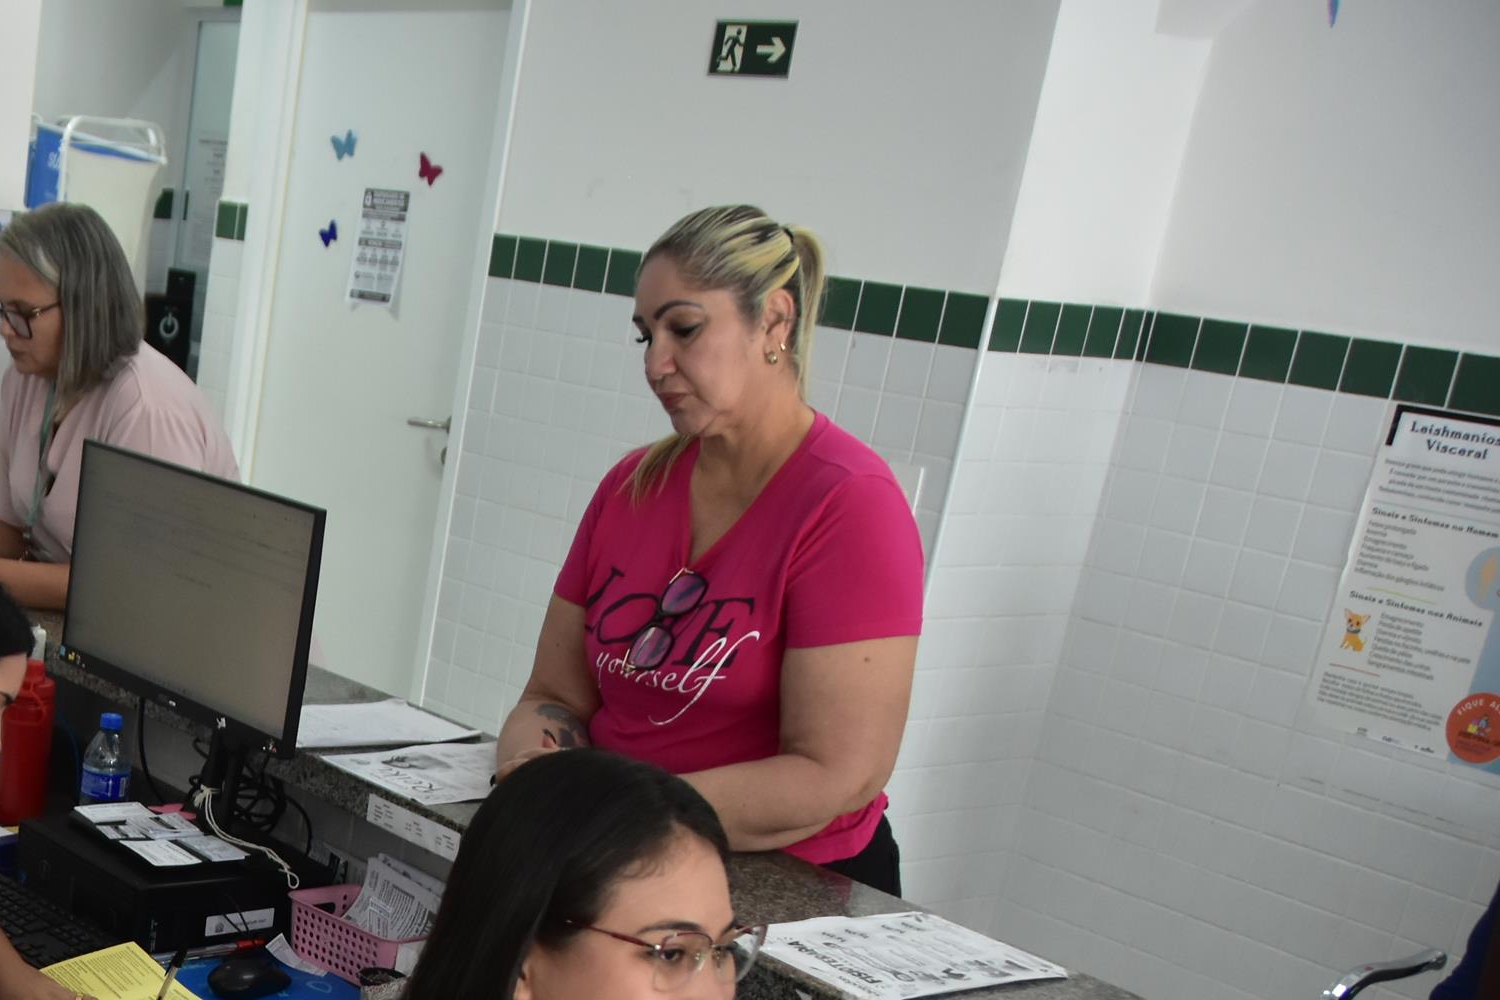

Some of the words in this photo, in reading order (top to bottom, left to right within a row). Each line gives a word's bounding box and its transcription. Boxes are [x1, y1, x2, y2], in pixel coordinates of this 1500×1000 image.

[1427, 438, 1488, 460] Visceral
[585, 565, 757, 669] LOE
[1385, 598, 1426, 614] Sintomas
[596, 630, 760, 726] yorself
[1457, 698, 1484, 716] FIQUE
